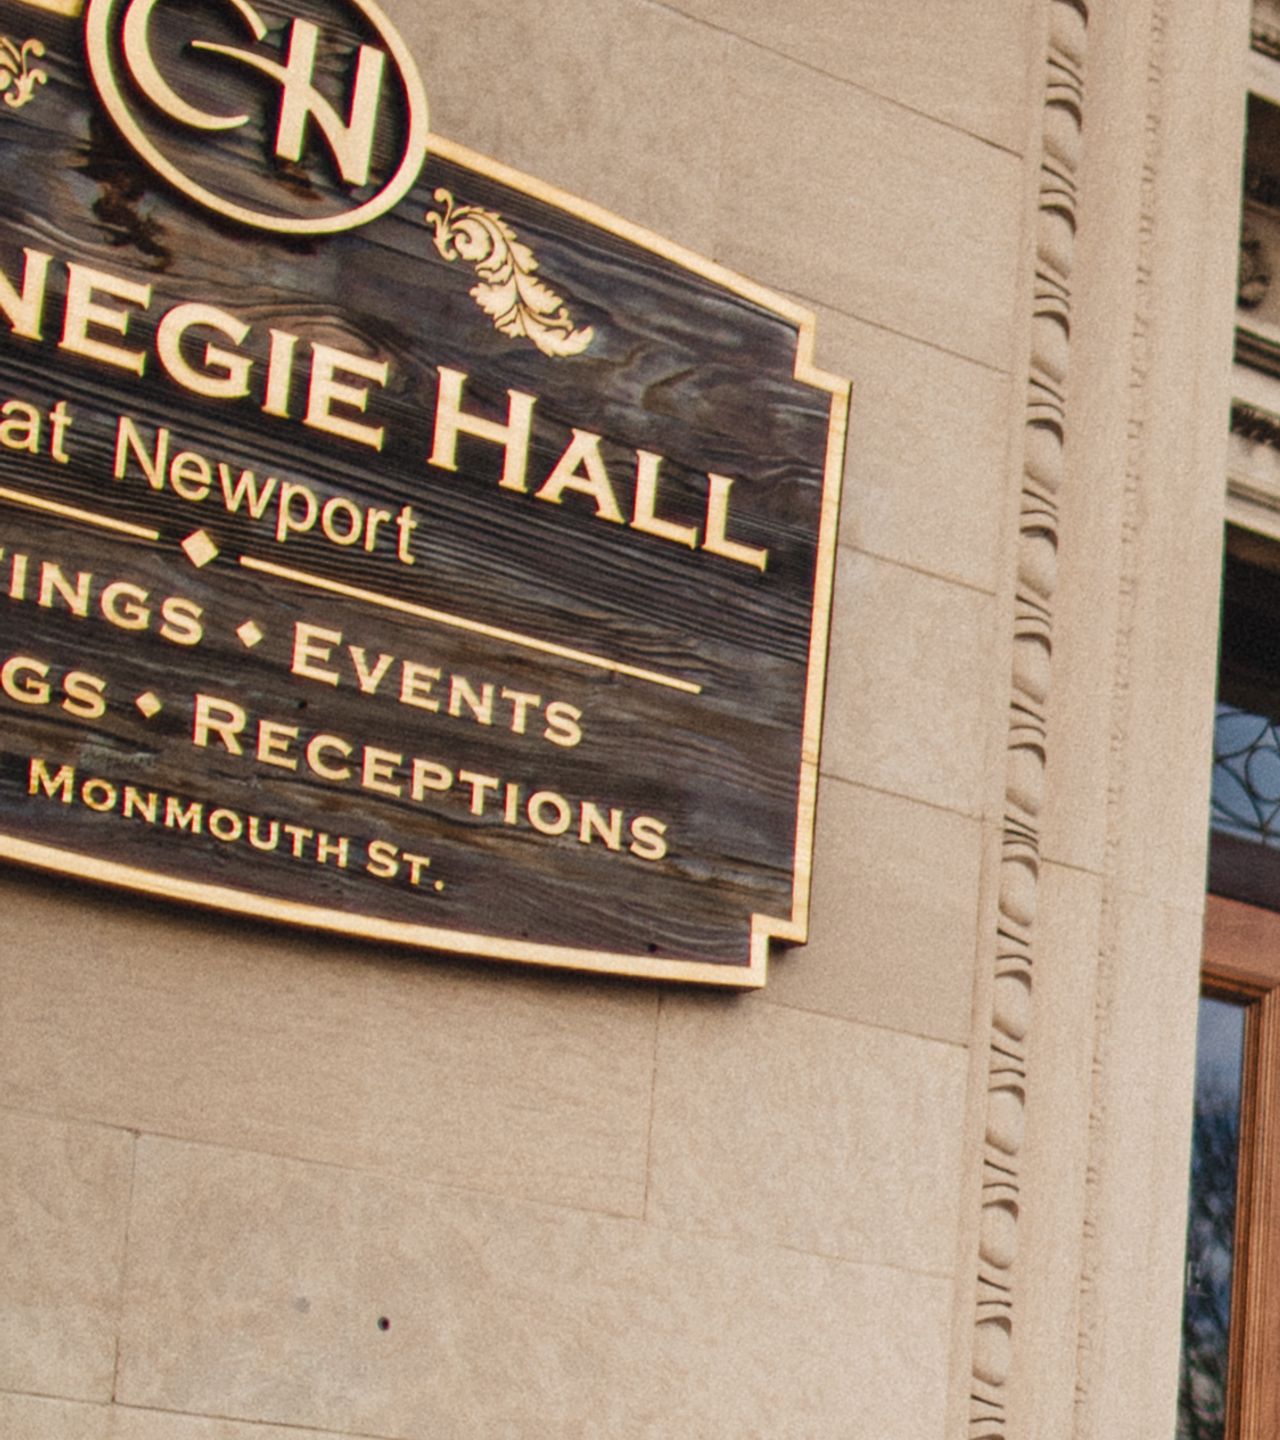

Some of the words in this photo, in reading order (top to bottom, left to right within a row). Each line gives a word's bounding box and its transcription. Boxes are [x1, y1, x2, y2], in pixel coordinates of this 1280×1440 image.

[0, 398, 73, 464] at
[113, 415, 418, 566] Newport
[426, 364, 768, 573] HALL
[0, 547, 204, 647] INGS
[290, 620, 584, 748] EVENTS
[0, 655, 107, 720] GS
[191, 692, 669, 861] RECEPTIONS
[28, 757, 350, 869] MONMOUTH
[365, 839, 446, 892] ST.
